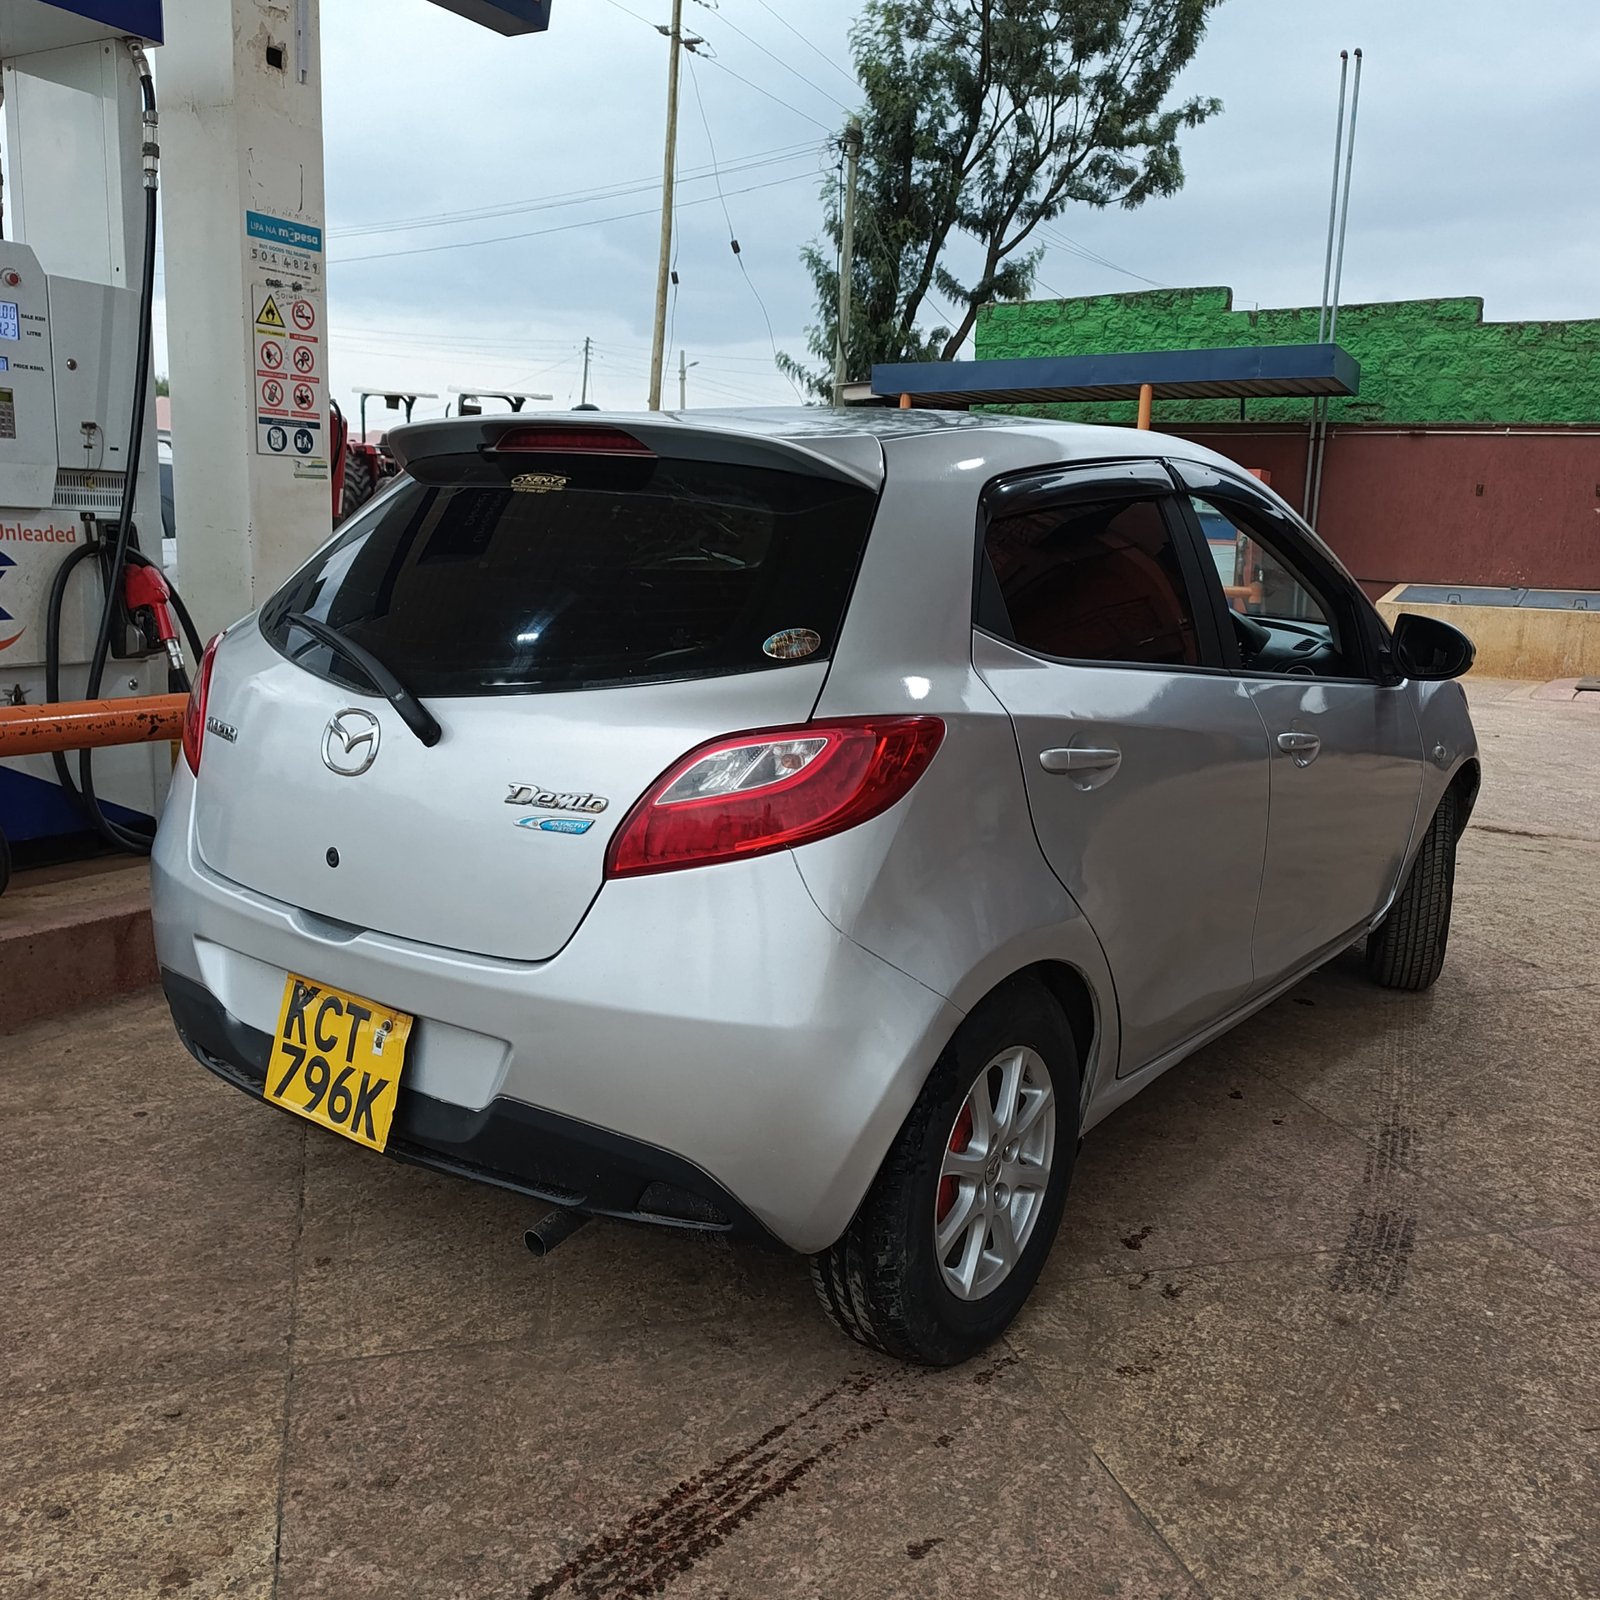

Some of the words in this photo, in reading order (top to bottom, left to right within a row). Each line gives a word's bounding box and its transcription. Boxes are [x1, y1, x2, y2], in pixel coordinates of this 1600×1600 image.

[250, 220, 264, 233] LIPA
[265, 225, 277, 236] NA
[20, 313, 34, 321] SALE
[504, 782, 609, 813] Demio
[283, 980, 372, 1063] KCT
[273, 1042, 390, 1142] 796K
